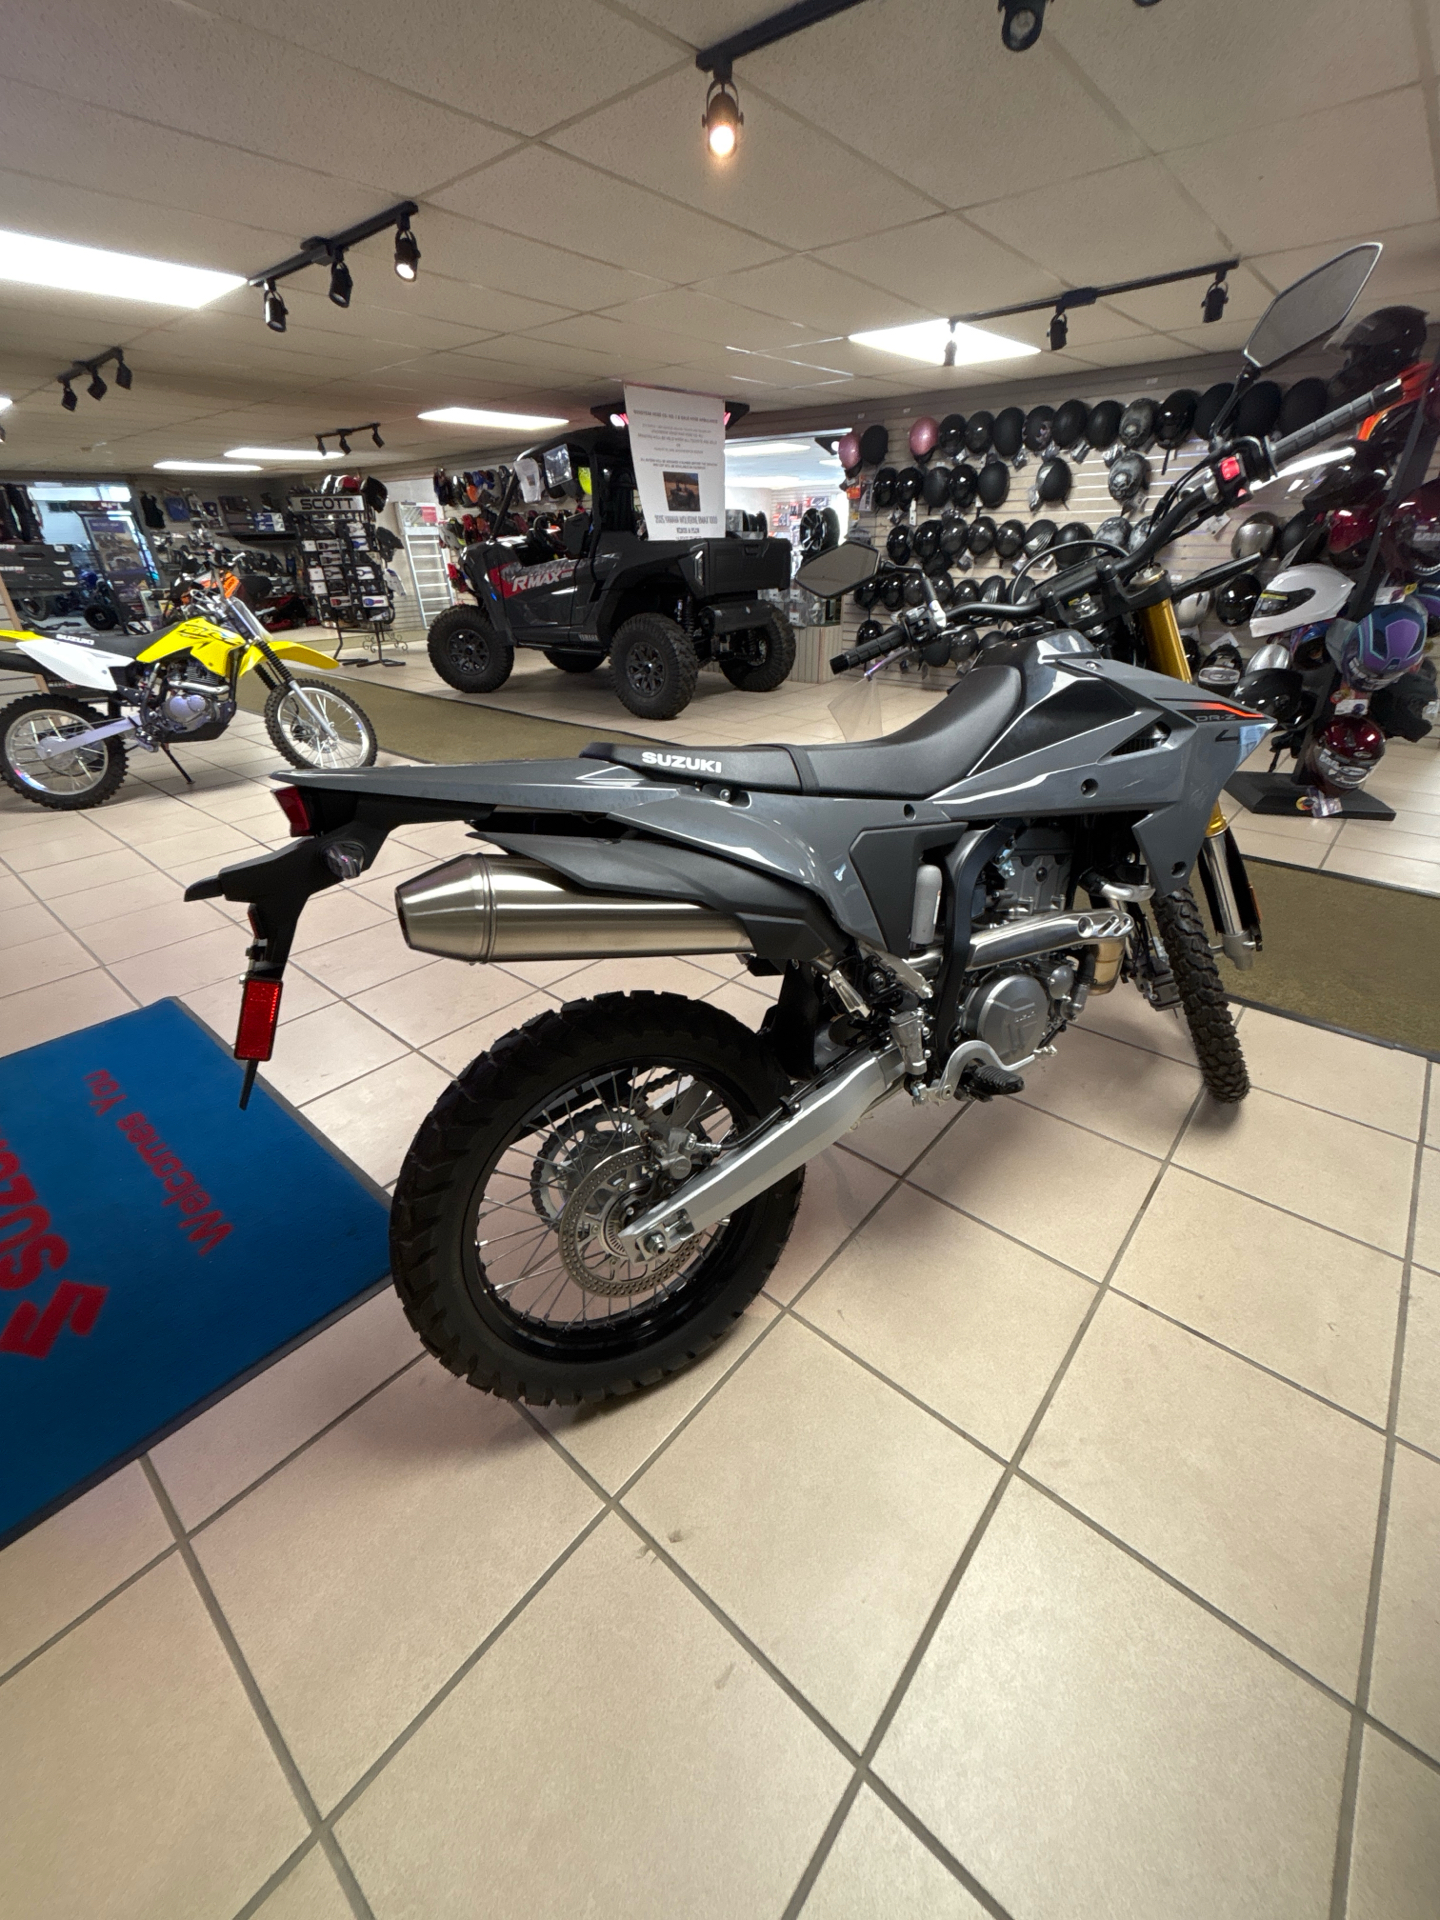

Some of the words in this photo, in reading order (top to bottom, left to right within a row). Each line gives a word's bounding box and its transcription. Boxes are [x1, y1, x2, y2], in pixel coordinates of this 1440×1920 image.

[300, 497, 354, 511] SCOTT
[512, 570, 561, 592] RMAX
[55, 633, 95, 647] SUZUKI
[641, 751, 722, 774] SUZUKI
[83, 1069, 128, 1116] You
[117, 1110, 235, 1256] Welcomes
